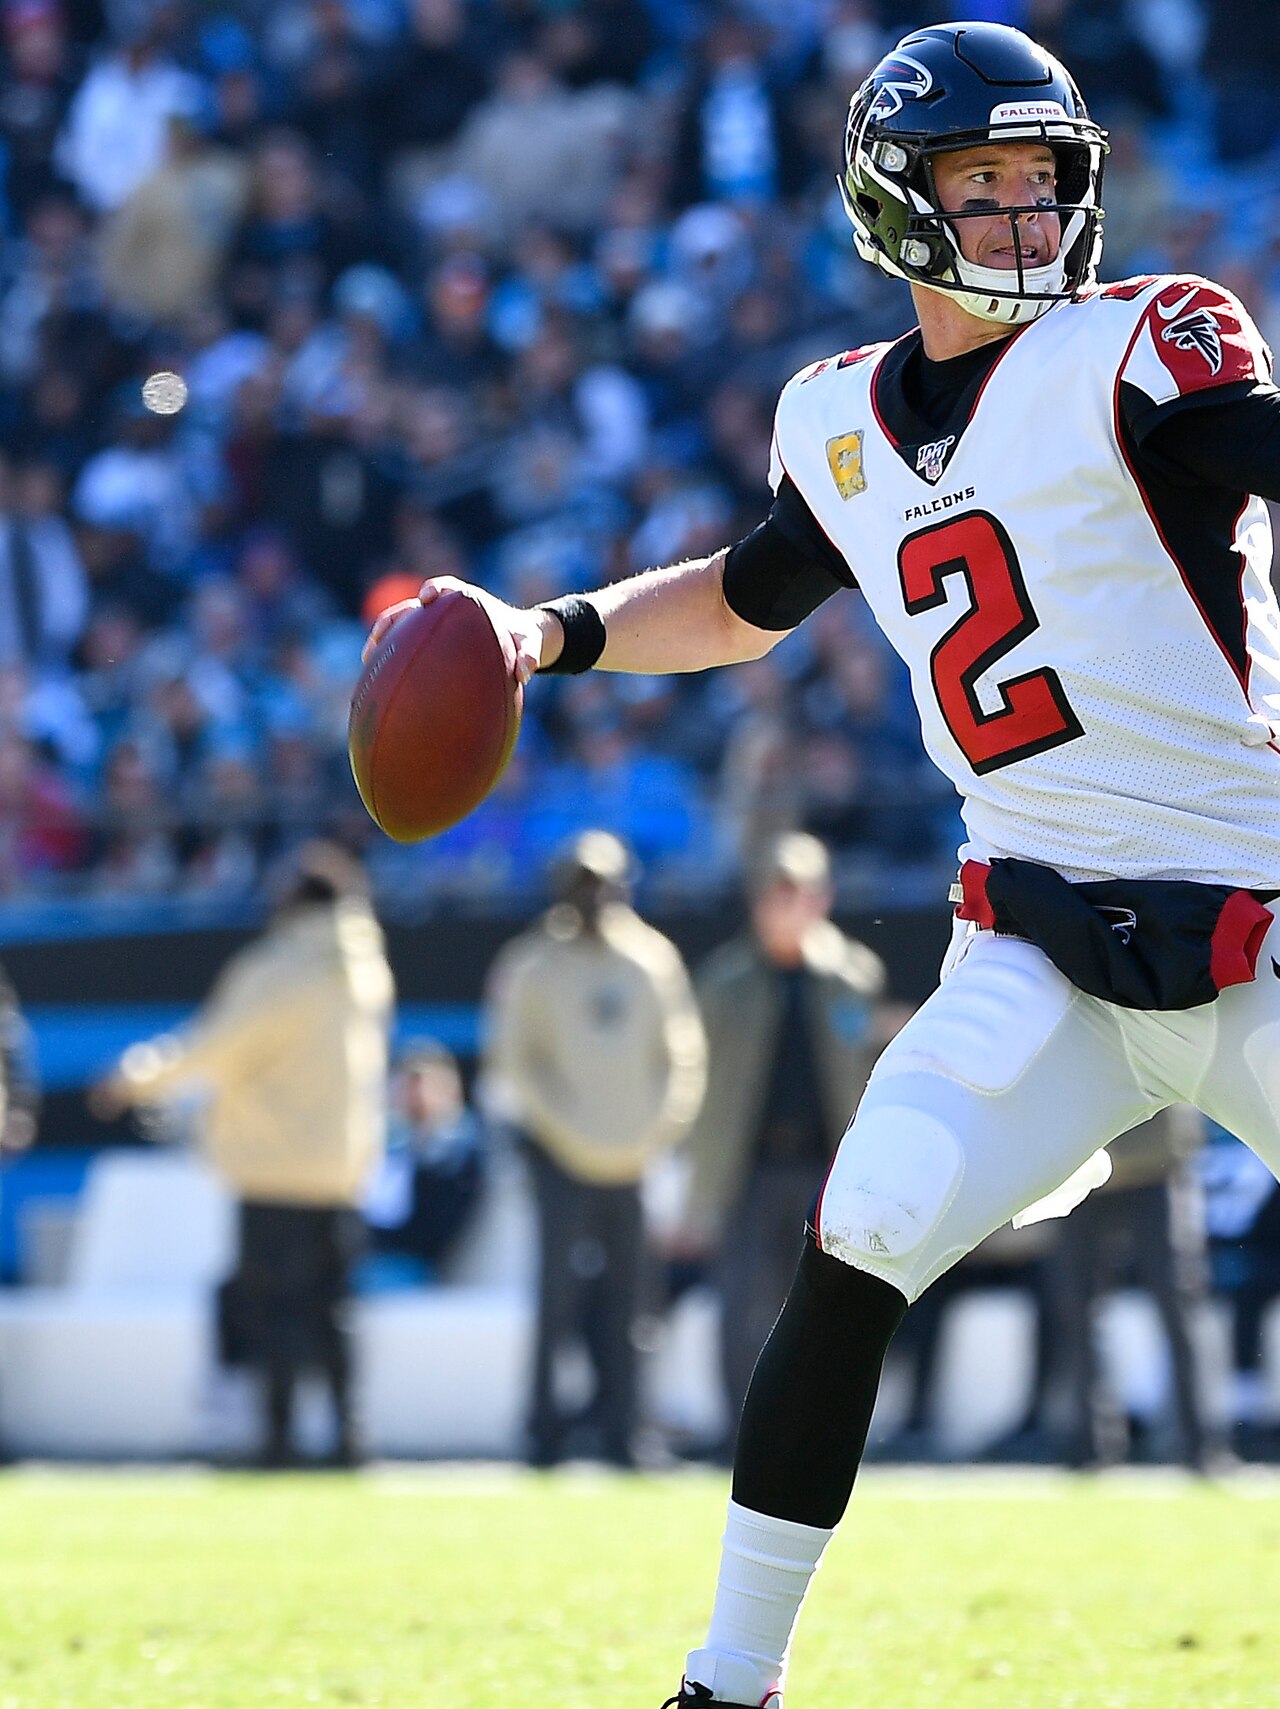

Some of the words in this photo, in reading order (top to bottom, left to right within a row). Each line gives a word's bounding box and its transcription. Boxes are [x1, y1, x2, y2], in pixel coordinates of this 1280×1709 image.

[1000, 107, 1061, 118] FALCONS
[904, 486, 976, 521] FALCONS
[896, 508, 1087, 778] 2
